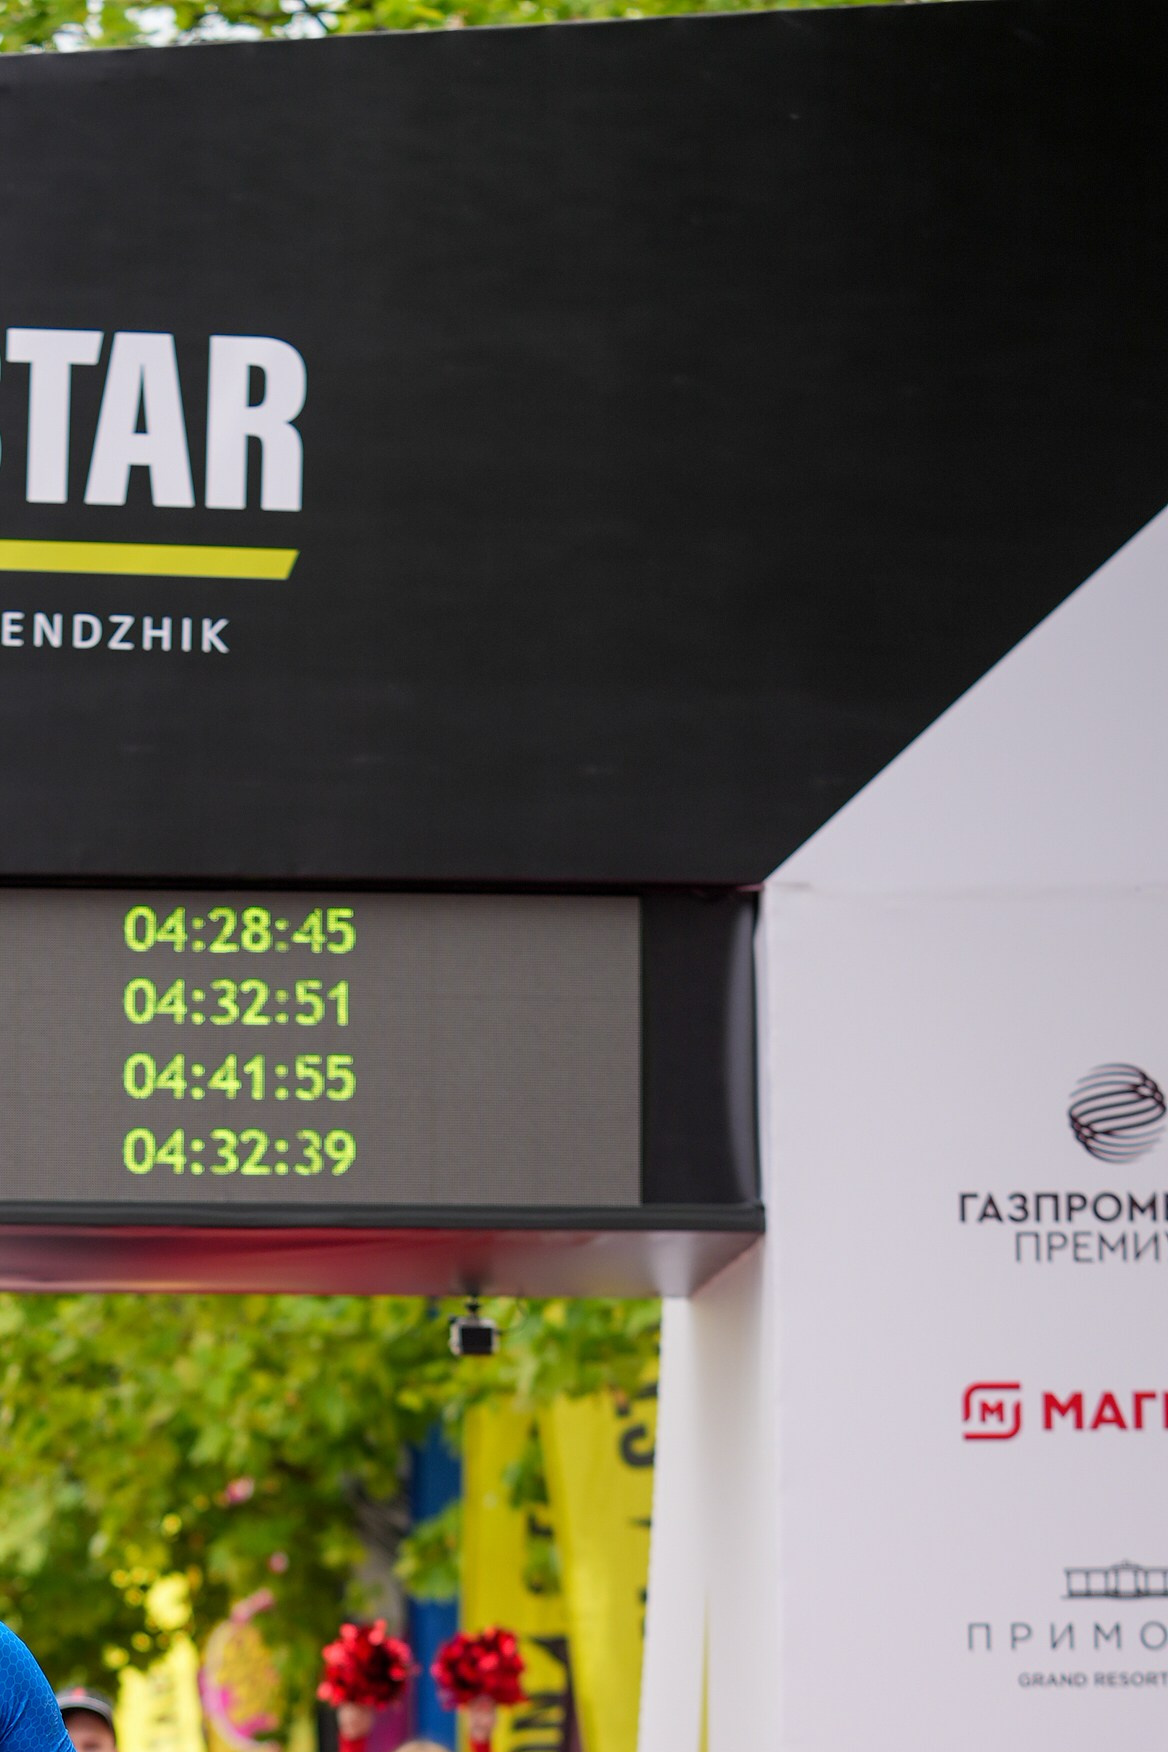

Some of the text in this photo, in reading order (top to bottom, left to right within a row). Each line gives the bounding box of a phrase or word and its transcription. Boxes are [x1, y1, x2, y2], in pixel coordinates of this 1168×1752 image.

[123, 904, 356, 953] 04:28:45
[123, 977, 350, 1026] 04:32:51
[123, 1052, 356, 1101] 04:41:55
[122, 1127, 357, 1176] 04:32:39
[959, 1191, 1168, 1224] ГАЗПРОМ
[1014, 1230, 1168, 1264] ПРЕМИ
[1042, 1391, 1168, 1431] МАГ
[966, 1620, 1168, 1652] ПРИМО
[1017, 1671, 1088, 1689] GRAND
